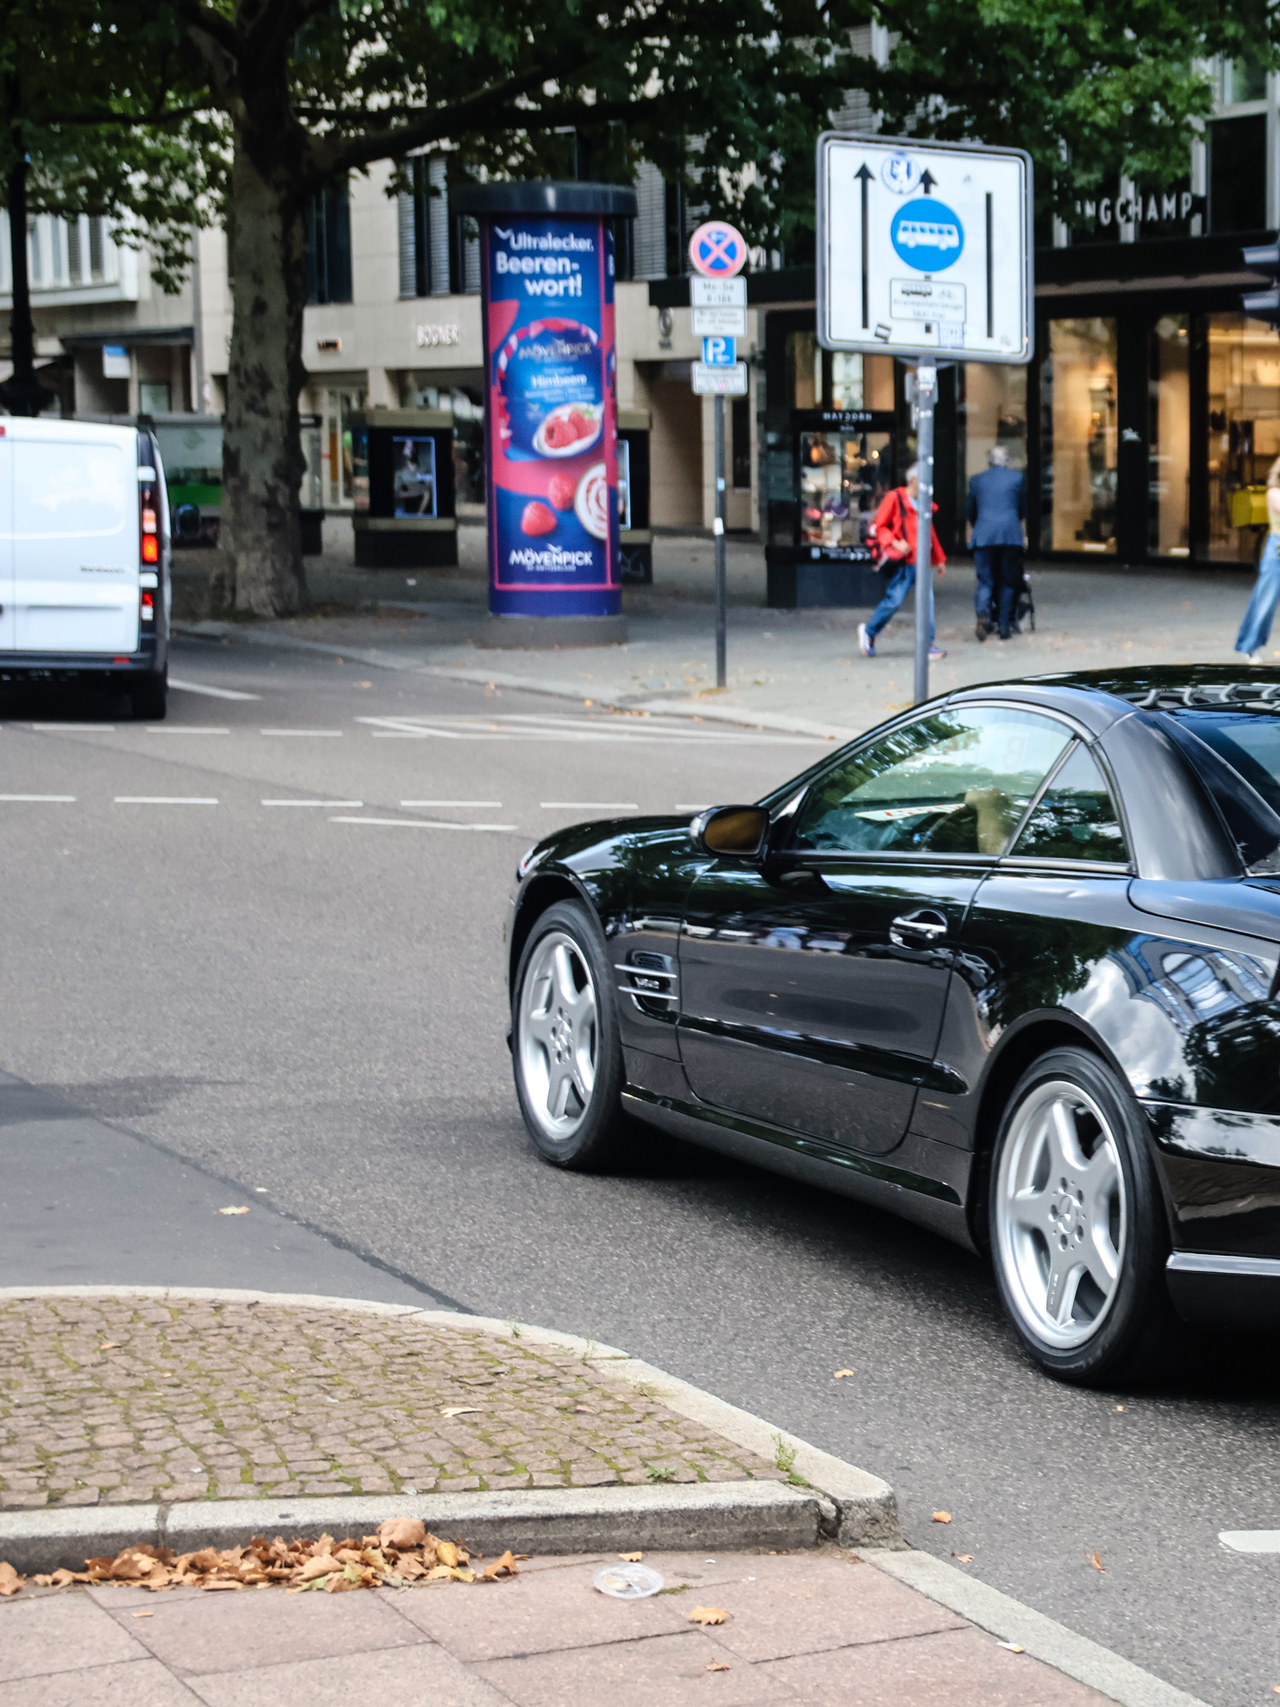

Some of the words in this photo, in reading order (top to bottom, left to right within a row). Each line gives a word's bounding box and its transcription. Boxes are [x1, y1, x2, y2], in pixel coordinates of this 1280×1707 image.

[509, 231, 594, 252] Ultralecker.
[495, 251, 580, 275] Beeren-
[524, 273, 583, 298] wort!
[417, 323, 458, 346] BOGNER
